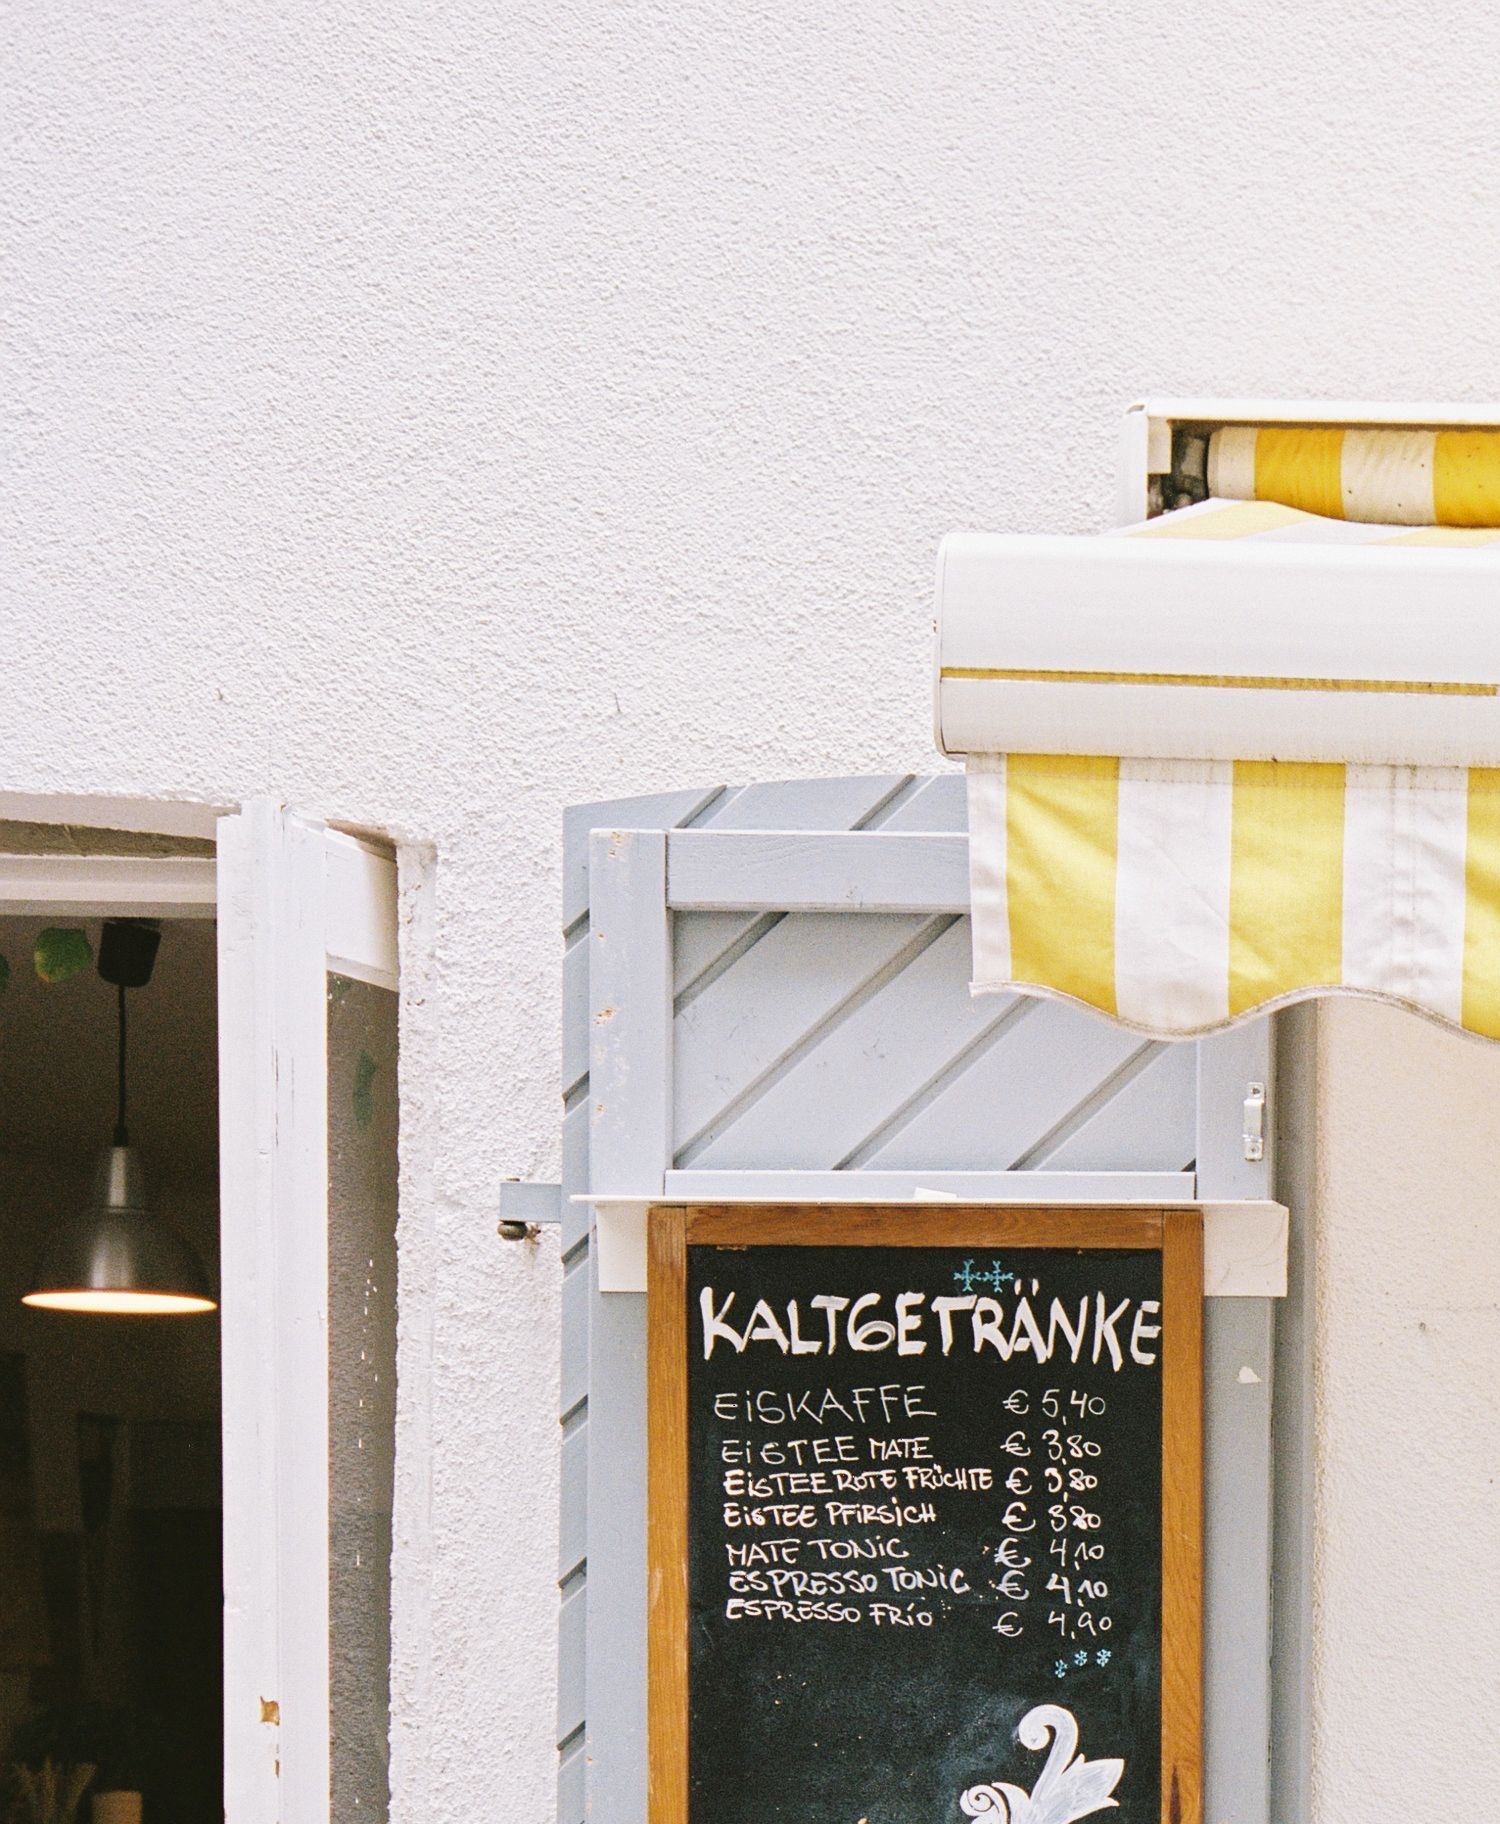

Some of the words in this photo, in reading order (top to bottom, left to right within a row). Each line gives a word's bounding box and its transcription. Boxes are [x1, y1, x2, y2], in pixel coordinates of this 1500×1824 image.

[700, 1278, 1161, 1372] KALTGETRÄNKE
[1002, 1389, 1030, 1415] €
[1041, 1388, 1106, 1426] 5,40
[868, 1436, 934, 1462] MATE
[1000, 1430, 1031, 1457] €
[1041, 1428, 1102, 1466] 3,80
[831, 1469, 898, 1492] ROTE
[901, 1462, 994, 1491] FRÜCHTE
[1004, 1466, 1033, 1495] €
[1043, 1466, 1098, 1503] 3,80
[1001, 1501, 1036, 1532] €
[724, 1538, 800, 1567] MATE
[994, 1536, 1032, 1569] €
[1049, 1537, 1105, 1571] 4,10
[728, 1569, 879, 1598] ESPRESSO
[995, 1569, 1030, 1601] €
[1045, 1572, 1109, 1608] 4,10
[725, 1598, 862, 1623] ESPRESSO
[991, 1611, 1024, 1638] €
[1047, 1610, 1113, 1640] 4,90
